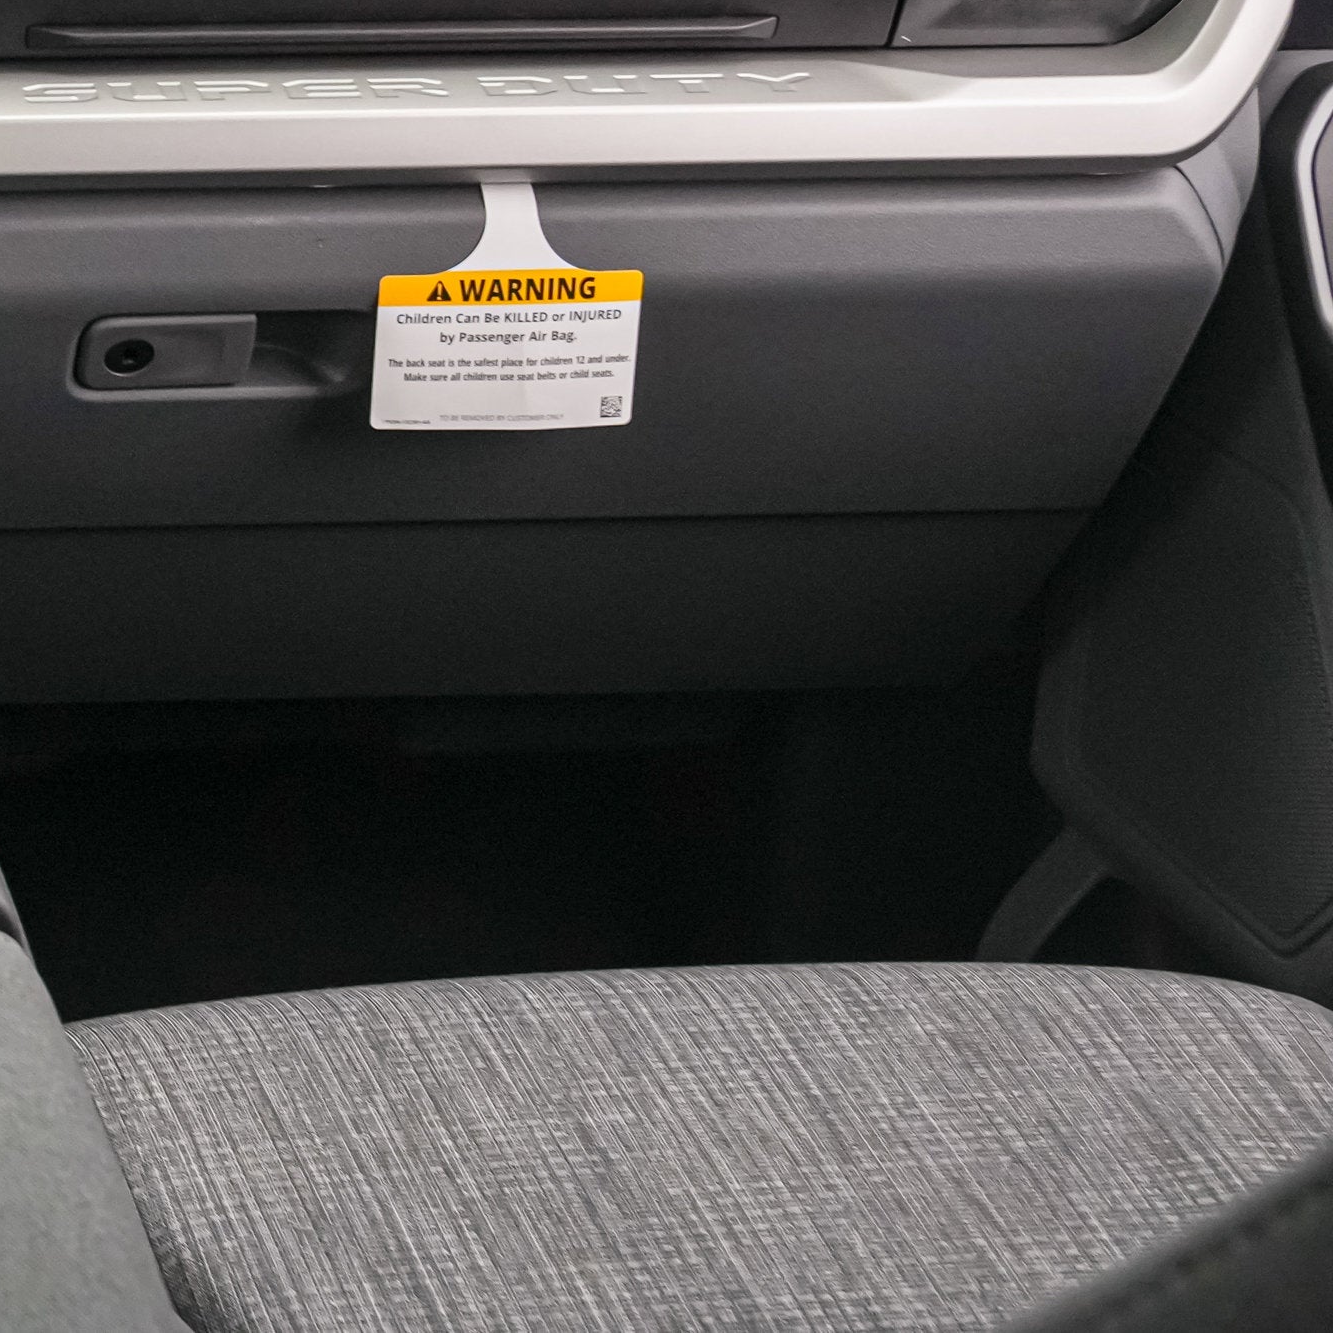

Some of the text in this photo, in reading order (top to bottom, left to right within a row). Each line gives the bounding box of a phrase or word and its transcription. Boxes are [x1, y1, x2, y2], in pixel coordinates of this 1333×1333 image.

[23, 73, 810, 102] SUPER DUTY
[460, 277, 596, 301] WARNING
[397, 309, 622, 324] Children Can Be KILLED or INJURED
[440, 330, 577, 345] by Passenger Air Bag.
[389, 359, 403, 367] The
[406, 358, 425, 367] back
[428, 359, 445, 367] seat
[448, 359, 455, 367] is
[457, 358, 471, 367] the
[474, 358, 498, 367] safest
[501, 357, 523, 368] place
[526, 357, 538, 366] for
[540, 357, 573, 366] children
[576, 356, 585, 364] 12
[587, 355, 603, 364] and
[404, 373, 427, 381] Make
[450, 373, 461, 381] all
[463, 372, 497, 381] children
[517, 373, 534, 381] seat
[537, 372, 556, 380] belts
[570, 370, 589, 379] child
